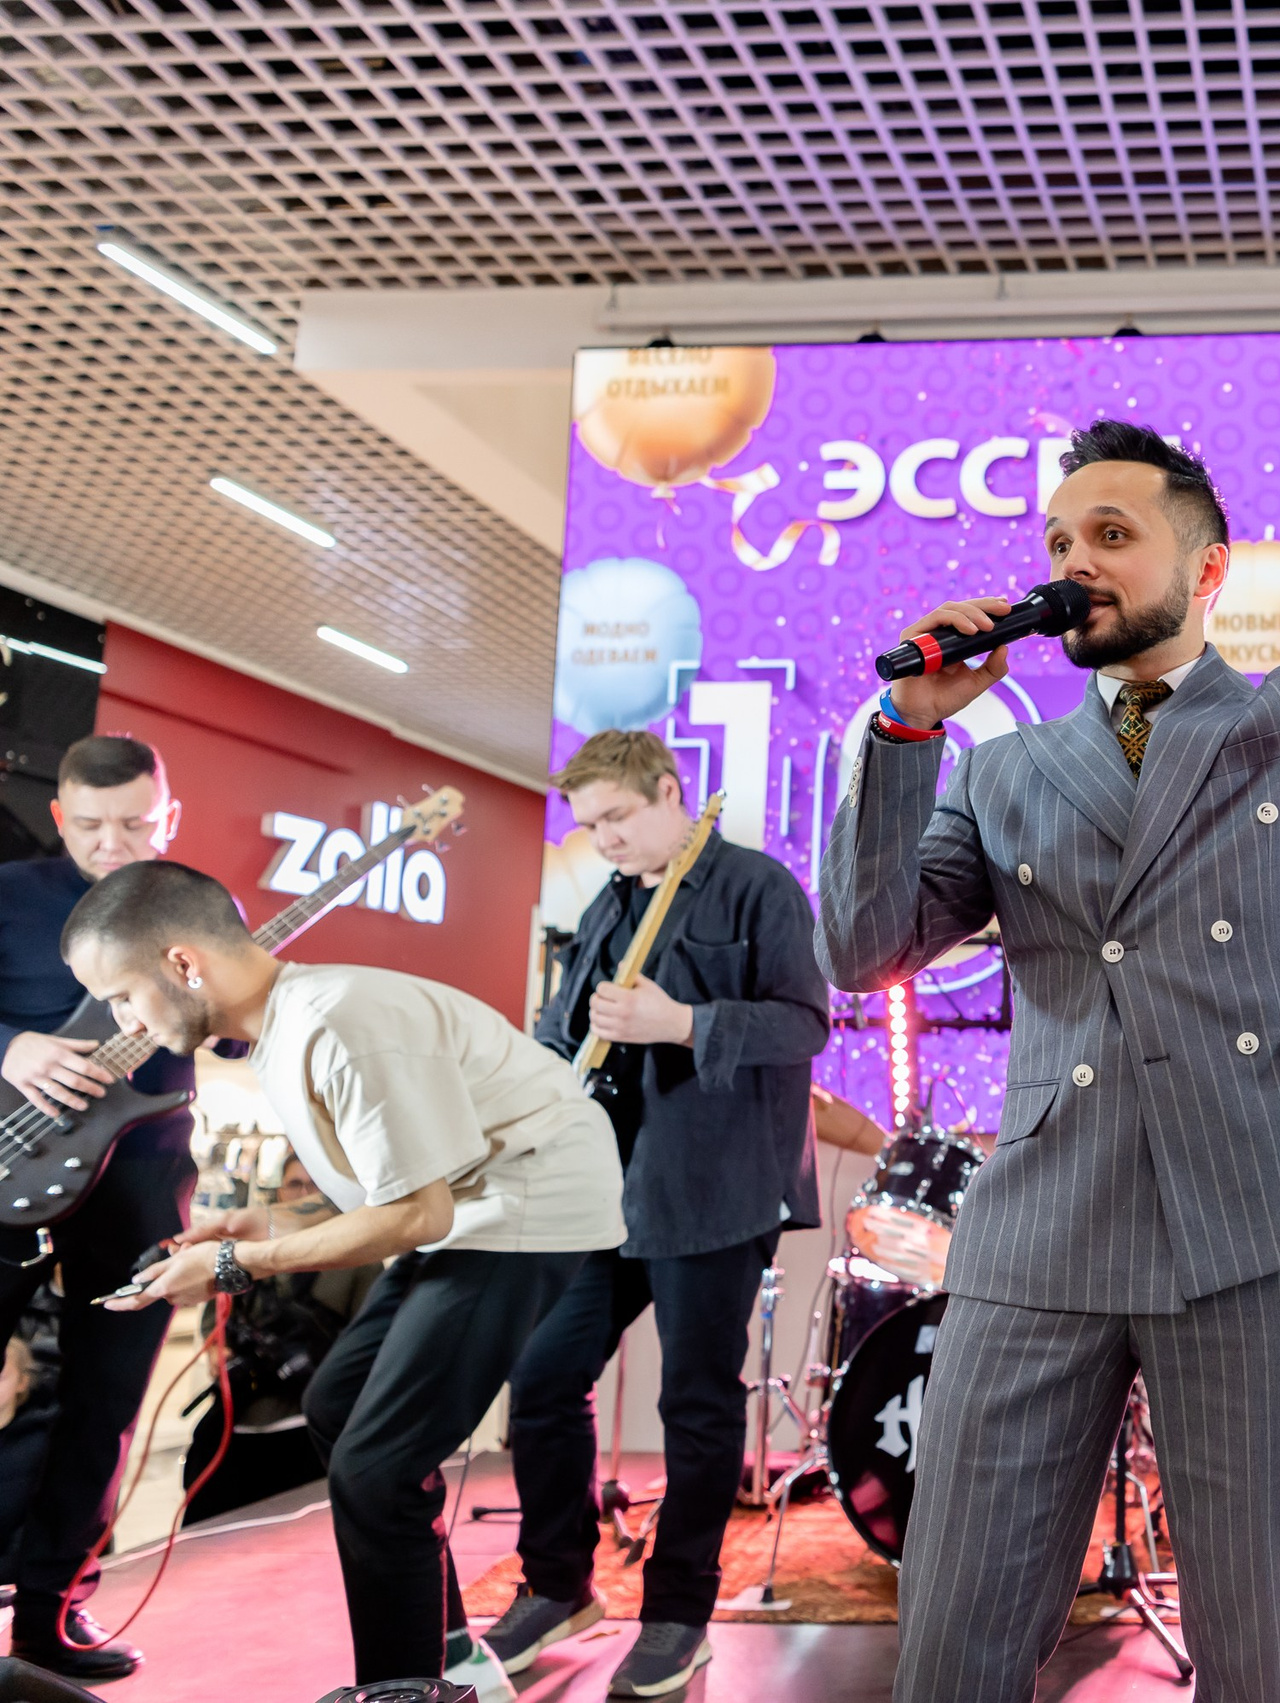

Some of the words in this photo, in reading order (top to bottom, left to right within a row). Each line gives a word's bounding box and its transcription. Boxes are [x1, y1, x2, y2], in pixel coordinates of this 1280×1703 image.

[607, 376, 731, 399] ОТДЫХАЕМ
[817, 437, 1076, 521] ЭСС
[268, 801, 447, 925] zolla
